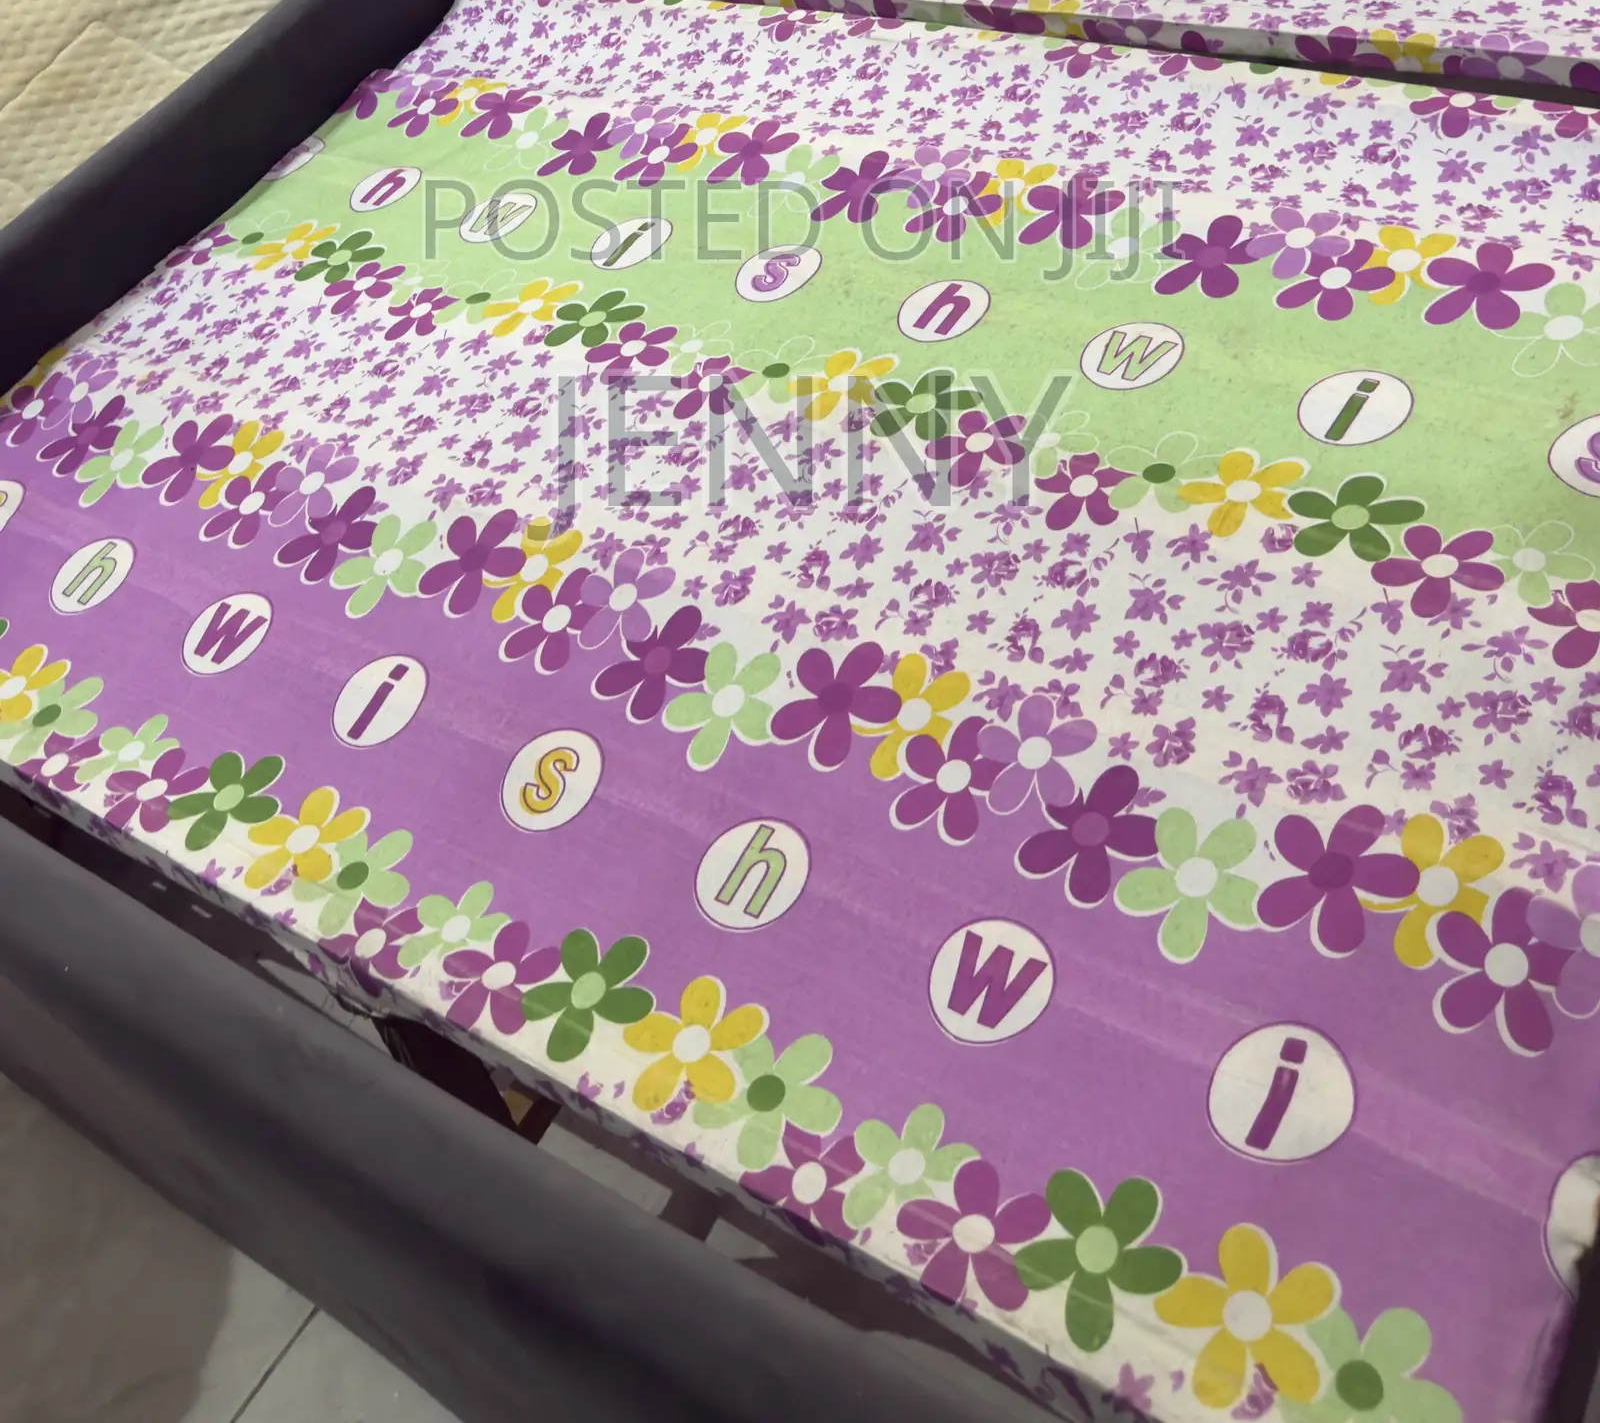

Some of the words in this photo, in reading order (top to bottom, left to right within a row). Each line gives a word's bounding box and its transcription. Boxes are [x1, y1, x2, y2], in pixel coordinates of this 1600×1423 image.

[359, 169, 406, 206] h
[912, 283, 971, 336] h
[1324, 378, 1380, 441] i
[62, 541, 117, 605] h
[346, 663, 409, 740] i
[714, 824, 787, 918] h
[1244, 1037, 1307, 1151] i
